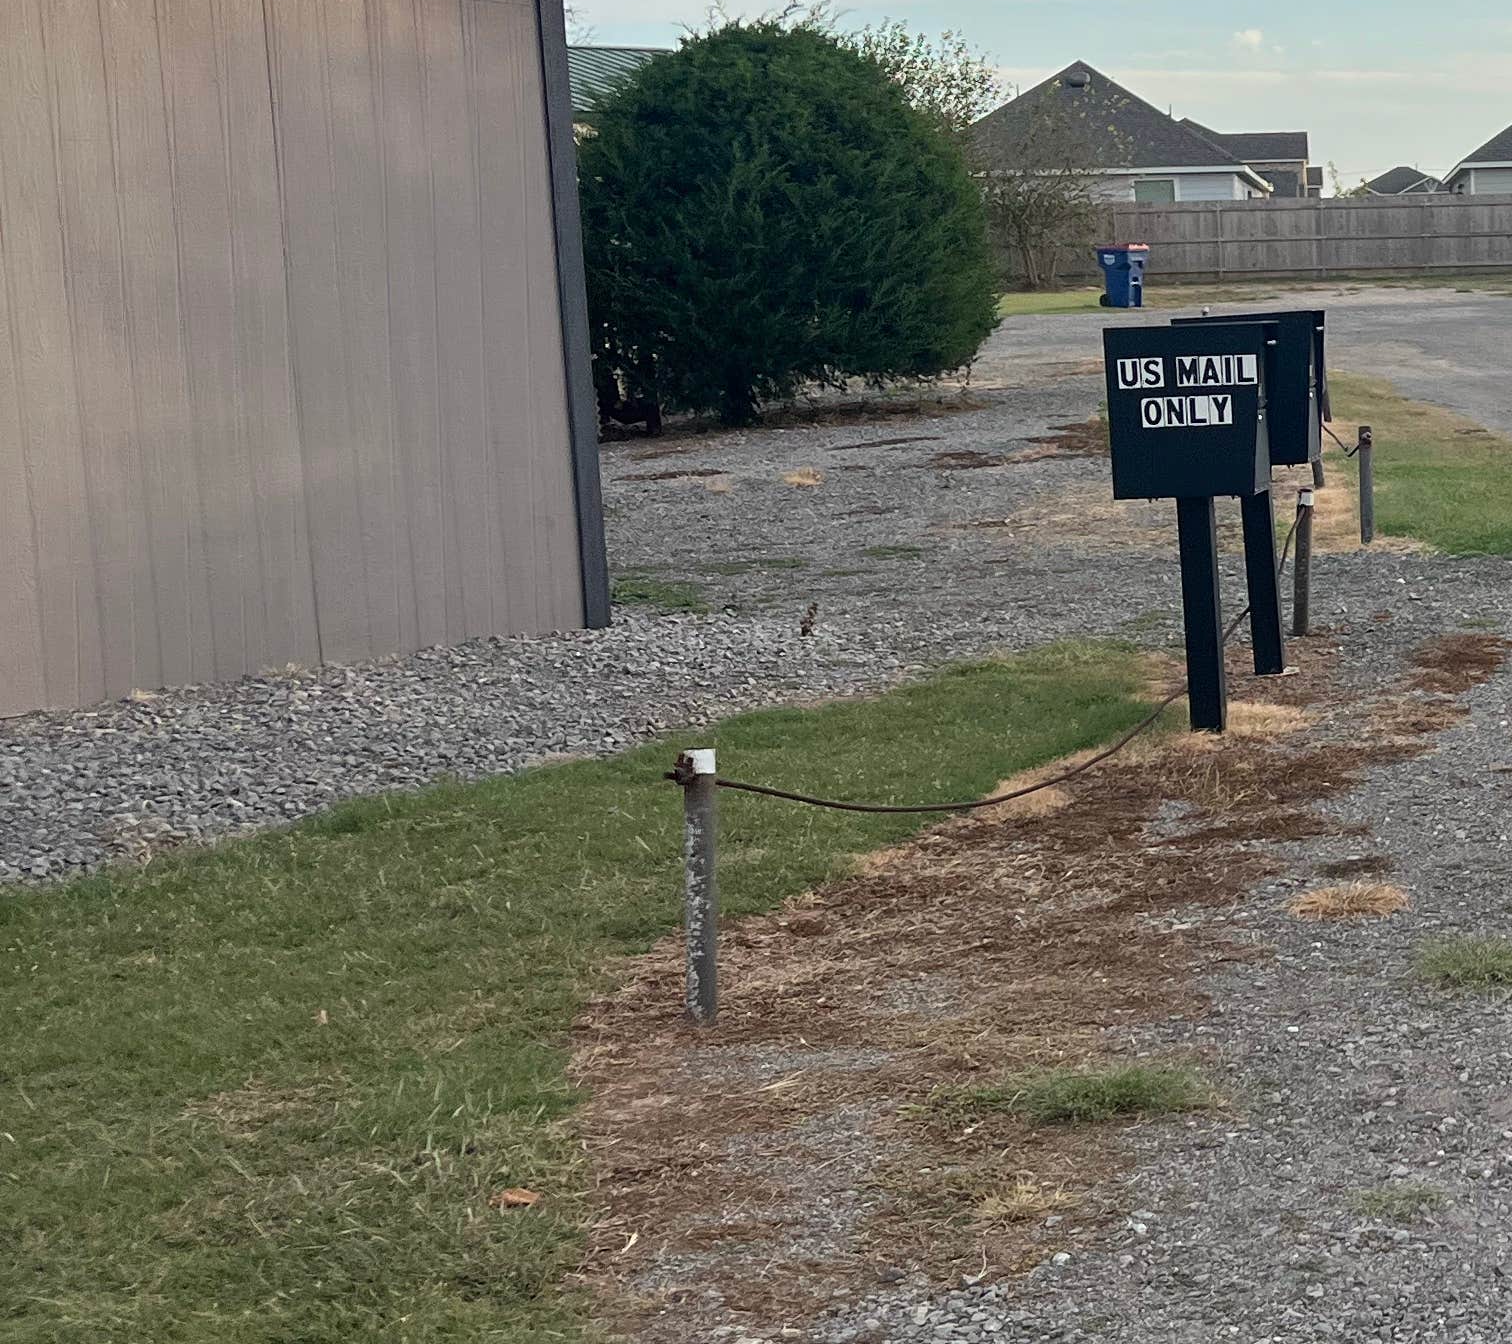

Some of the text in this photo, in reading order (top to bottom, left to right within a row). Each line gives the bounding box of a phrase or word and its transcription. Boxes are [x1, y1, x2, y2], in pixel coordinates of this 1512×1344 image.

[1119, 356, 1255, 387] US MAIL
[1143, 396, 1229, 426] ONLY
